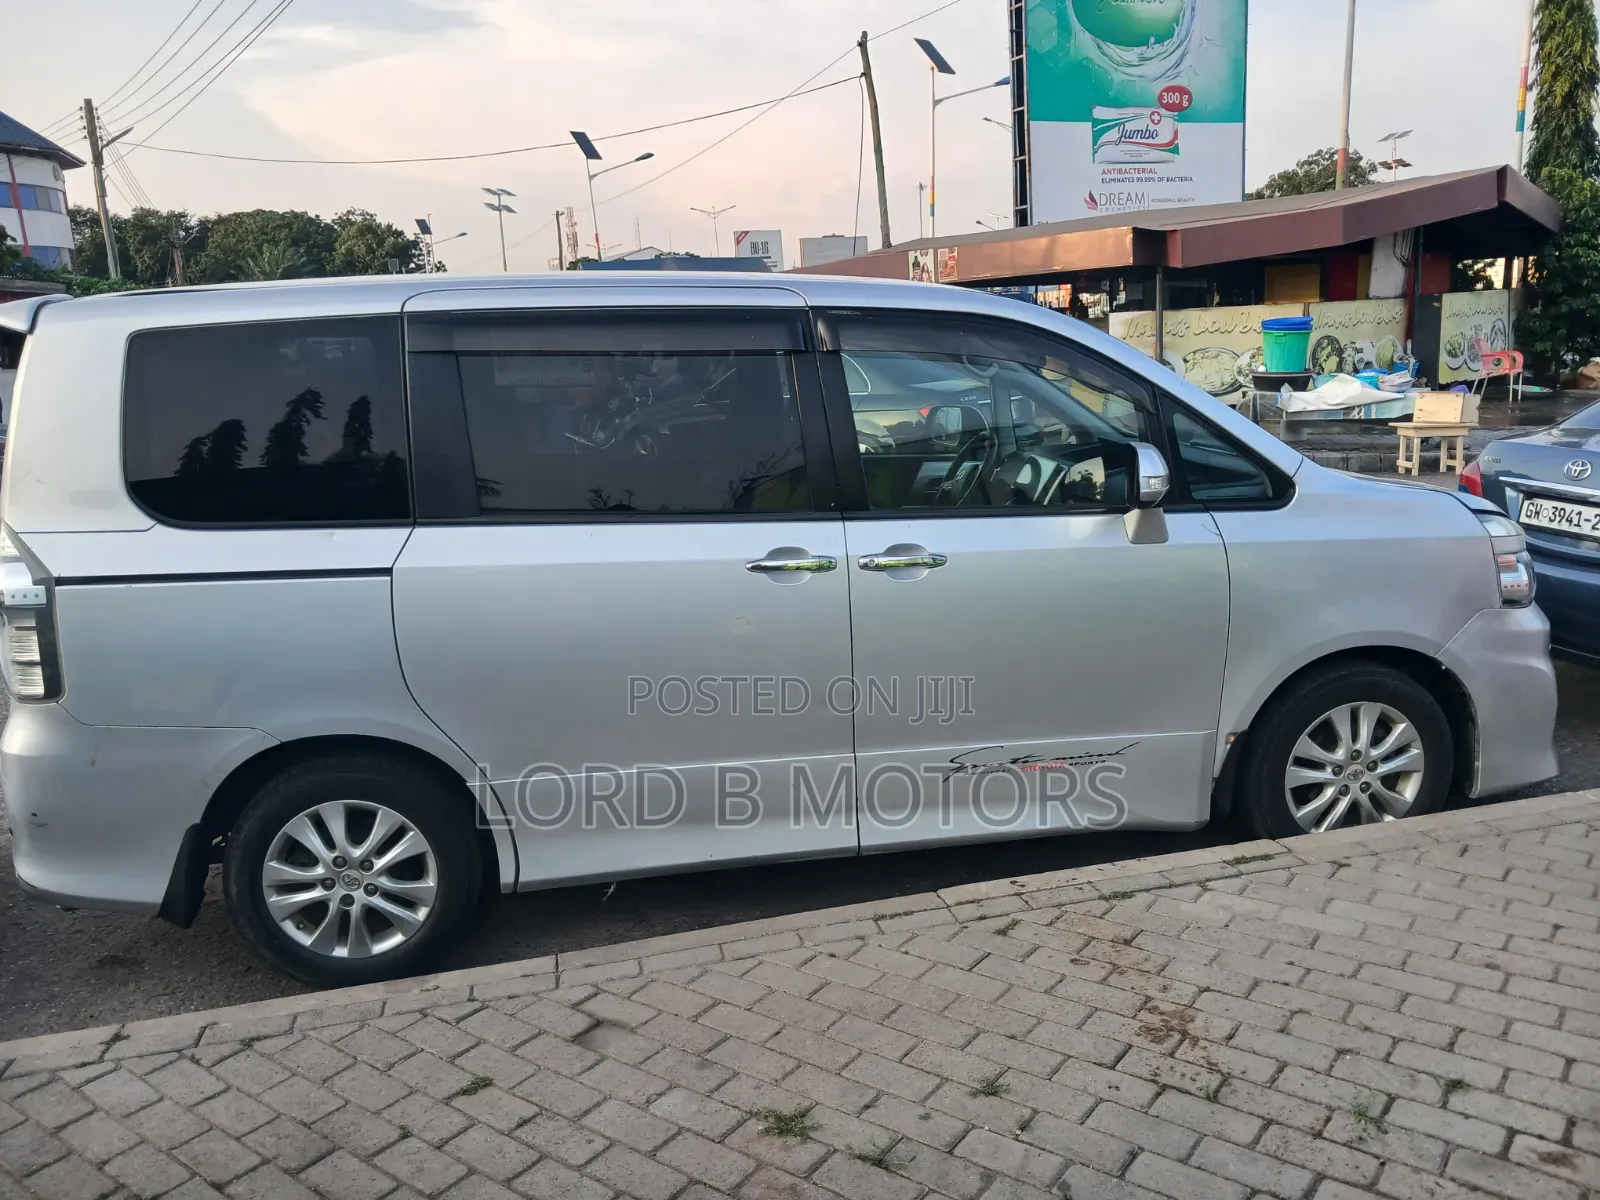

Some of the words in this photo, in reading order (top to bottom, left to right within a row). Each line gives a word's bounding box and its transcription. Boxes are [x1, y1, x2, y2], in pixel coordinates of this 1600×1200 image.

[1161, 92, 1180, 104] 300
[1182, 95, 1189, 107] g
[1115, 122, 1159, 146] Jumbo
[1099, 192, 1146, 206] DREAM
[1100, 205, 1146, 213] COSMETICS
[1525, 502, 1543, 520] GW
[1028, 761, 1066, 772] TOYOTA
[1068, 759, 1107, 767] SPORTS
